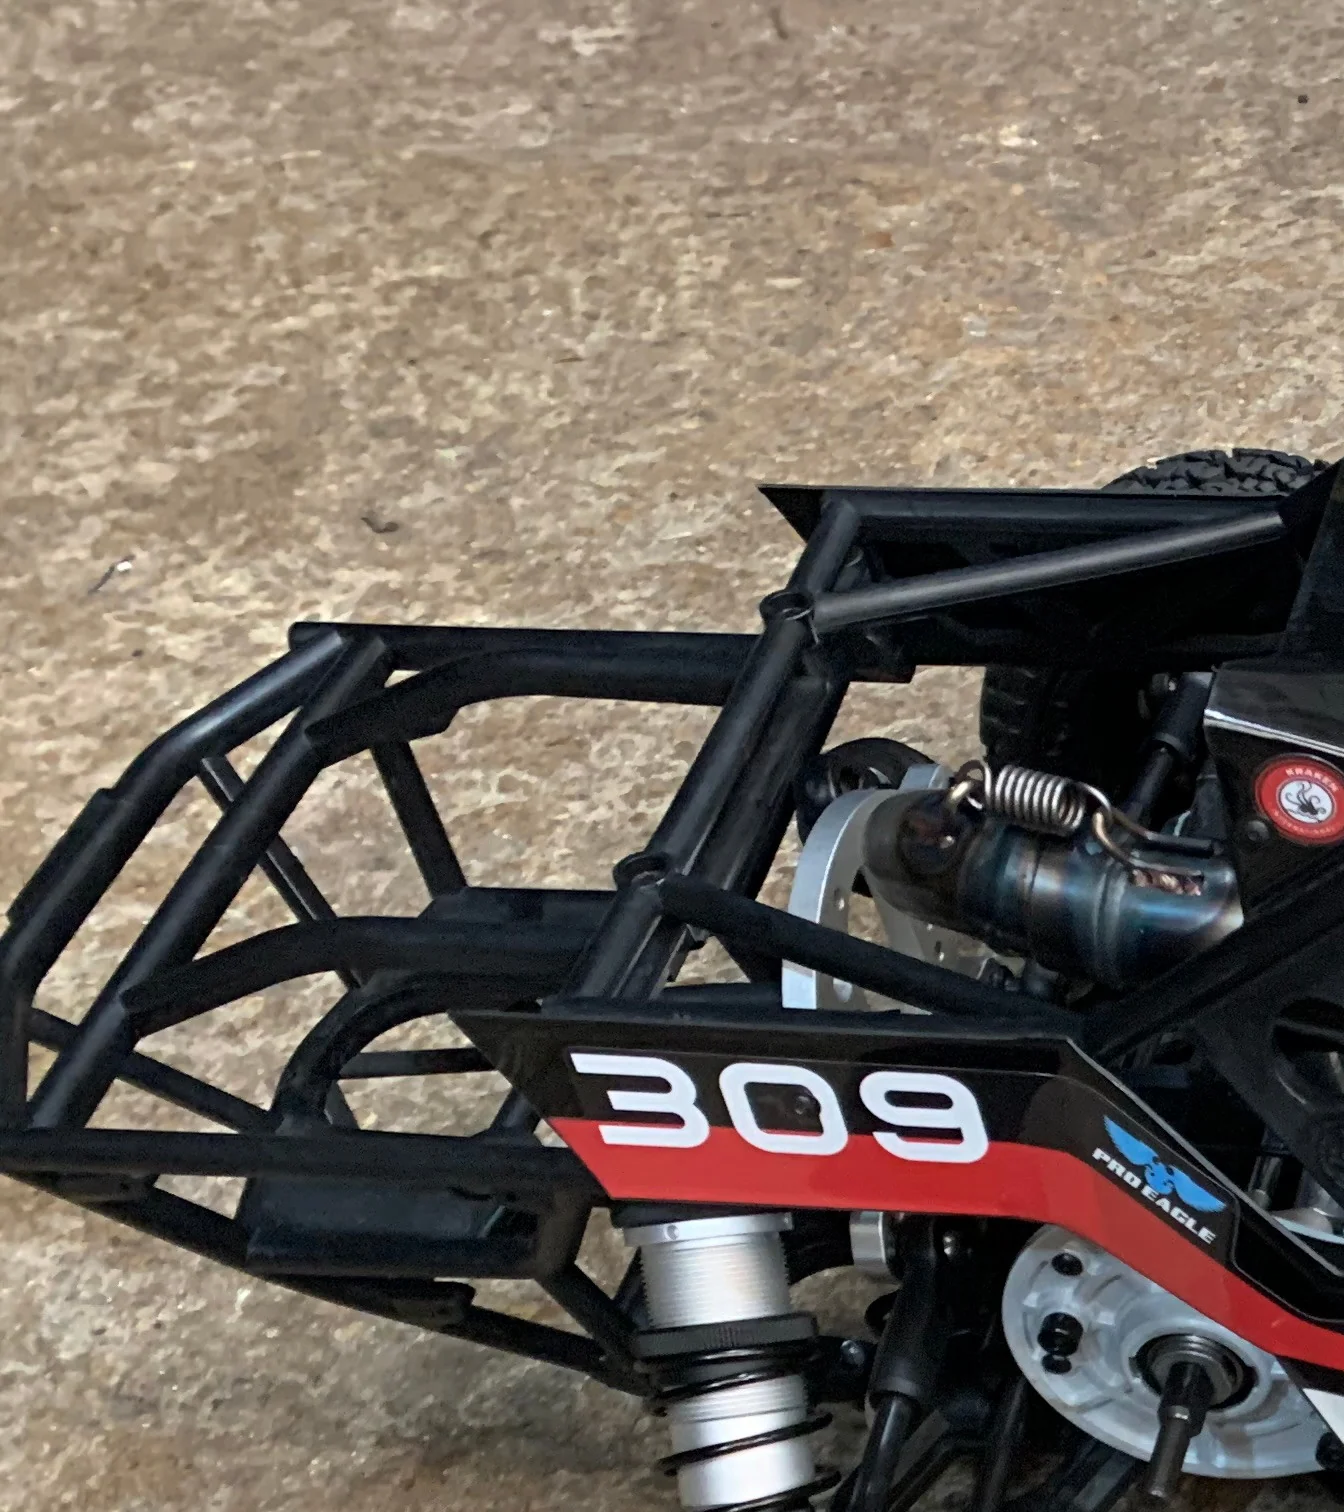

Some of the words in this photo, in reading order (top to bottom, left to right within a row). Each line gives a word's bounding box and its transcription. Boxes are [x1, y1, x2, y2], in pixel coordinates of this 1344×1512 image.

[570, 1052, 990, 1164] 309
[1091, 1147, 1142, 1189] PRO
[1140, 1185, 1217, 1244] EAGLE
